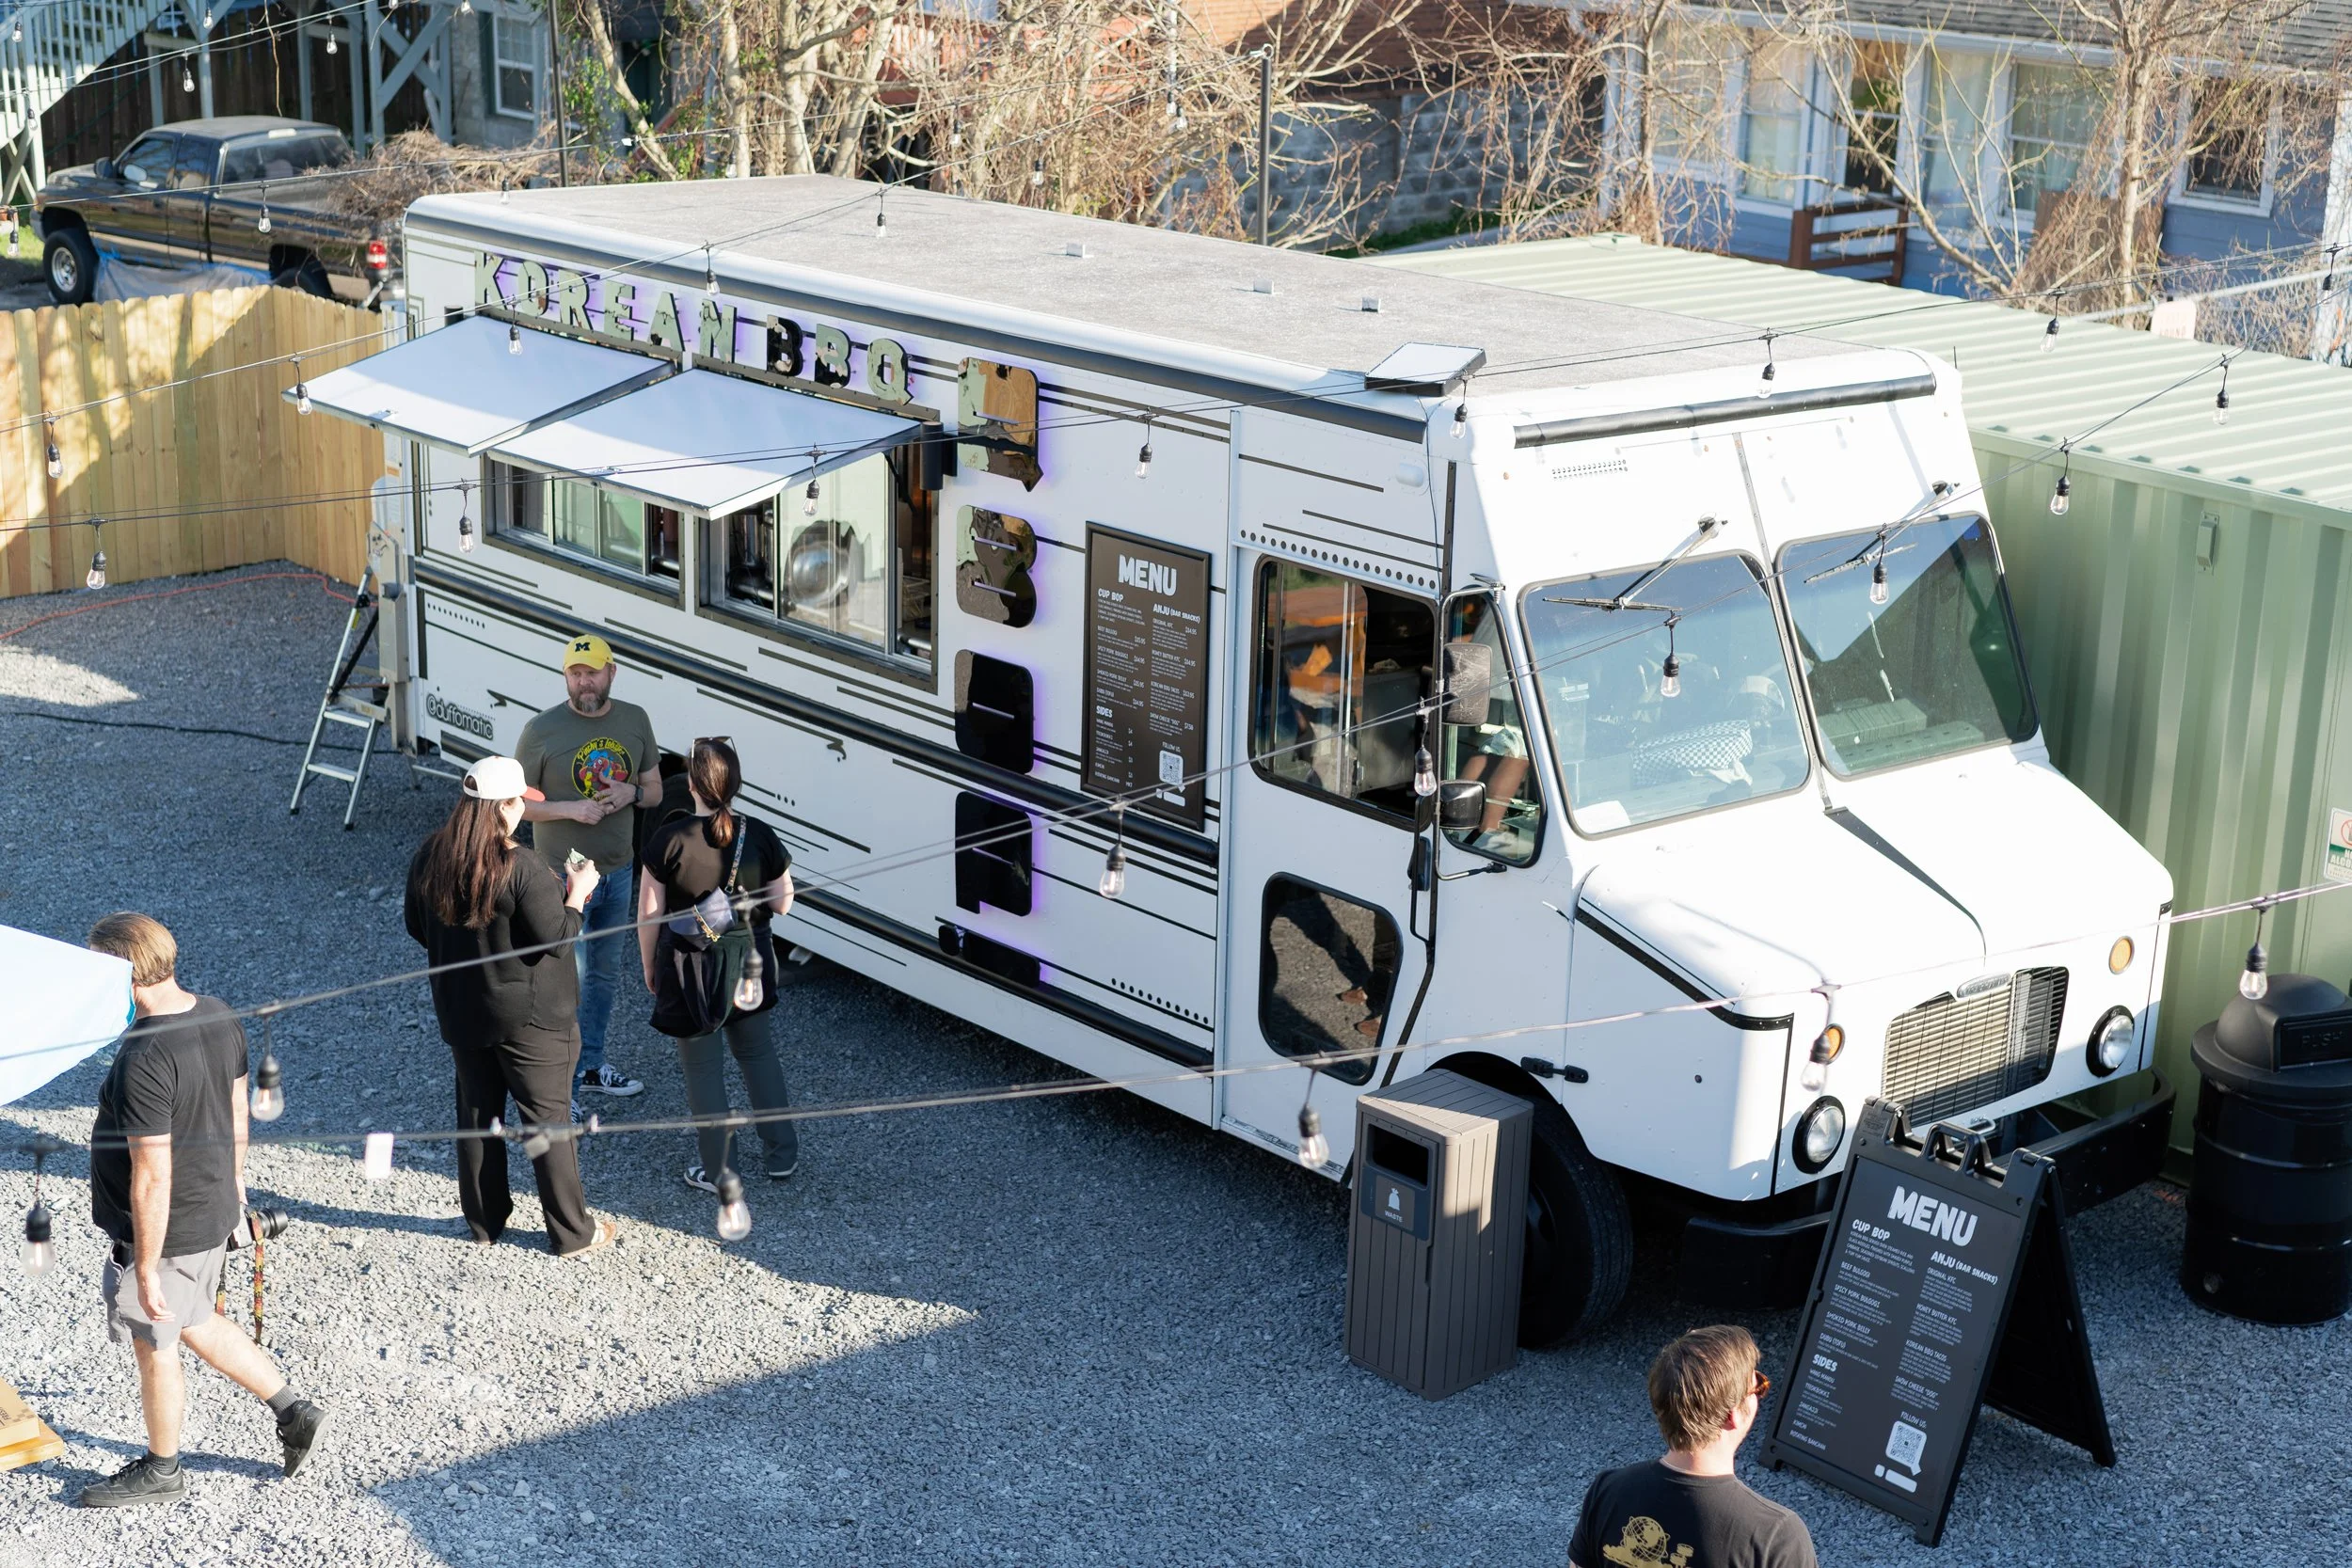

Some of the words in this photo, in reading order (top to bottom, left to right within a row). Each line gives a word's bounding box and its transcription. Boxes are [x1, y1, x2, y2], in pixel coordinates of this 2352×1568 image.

[474, 250, 738, 364] KOREAN
[767, 314, 914, 406] BBQ
[1119, 554, 1177, 597] MENU
[1098, 588, 1110, 599] CUP
[1112, 592, 1123, 603] BOP
[1153, 603, 1169, 615] ANJU
[575, 642, 590, 652] M
[427, 693, 494, 740] @duffomatic
[1096, 705, 1112, 718] SIDES
[1385, 1211, 1403, 1223] WASTE
[1887, 1185, 1979, 1249] MENU
[1851, 1218, 1871, 1234] CUP
[1871, 1227, 1891, 1243] BOP
[1841, 1261, 1852, 1271] BEEF
[1852, 1266, 1871, 1278] BULGOGI
[1927, 1267, 1947, 1280] ORIGINAL
[1947, 1275, 1957, 1284] KFC
[1931, 1250, 1956, 1269] ANJU
[1955, 1259, 1972, 1275] (BAR
[1971, 1267, 1998, 1286] SNACKS)
[1835, 1284, 1848, 1294] SPICY
[1848, 1290, 1860, 1300] PORK
[1860, 1294, 1881, 1308] BULGOGI
[1826, 1311, 1845, 1323] SMOKED
[1845, 1319, 1858, 1329] PORK
[1857, 1324, 1871, 1335] BELLY
[1916, 1303, 1931, 1314] HONEY
[1931, 1309, 1948, 1321] BUTTER
[1947, 1316, 1958, 1325] KFC
[1905, 1338, 1924, 1352] KOREAN
[1924, 1347, 1934, 1356] BBQ
[1933, 1351, 1947, 1362] TACOS
[1812, 1353, 1838, 1373] SIDES
[1895, 1375, 1909, 1386] SNOW
[1908, 1381, 1925, 1394] CHEESE
[1900, 1411, 1920, 1425] FOLLOW
